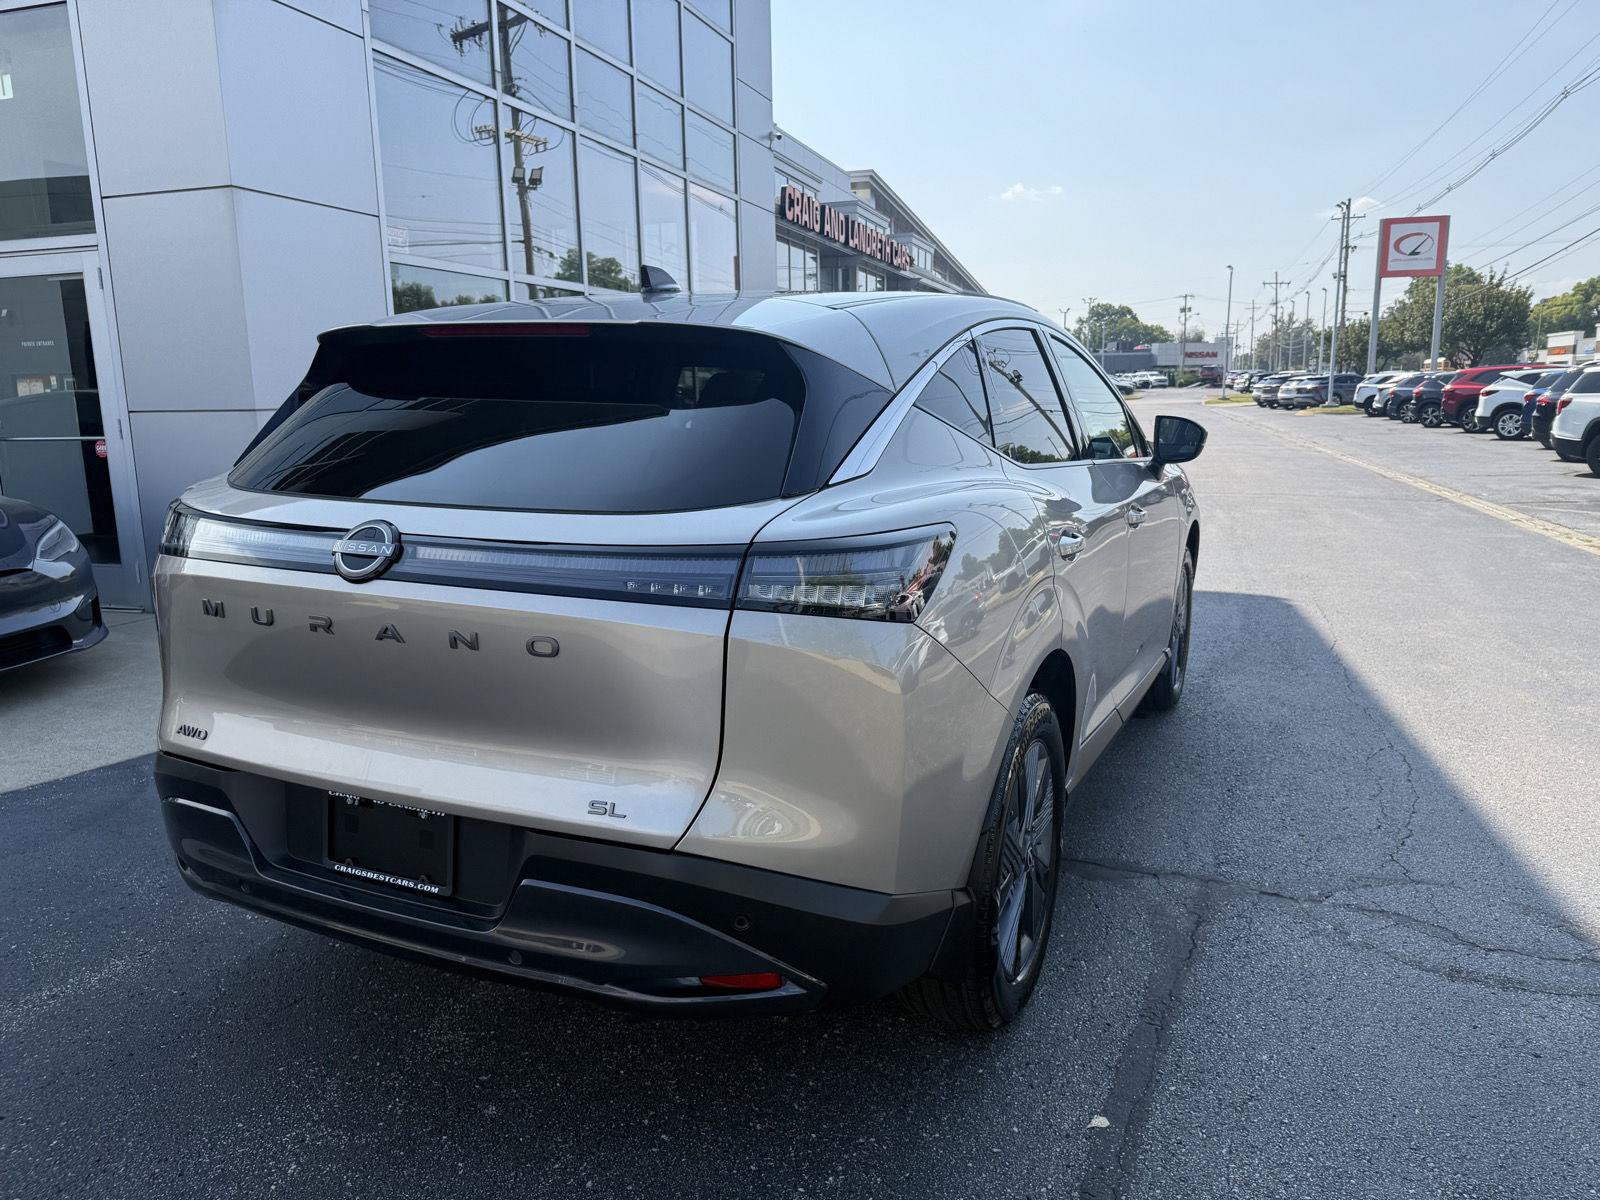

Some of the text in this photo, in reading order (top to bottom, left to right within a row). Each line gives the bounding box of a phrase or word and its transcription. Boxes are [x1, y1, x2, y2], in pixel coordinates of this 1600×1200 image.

[785, 184, 912, 271] CRAIG AND LANDRETH CARS
[334, 540, 393, 554] NISSAN
[202, 598, 560, 658] MURANO
[176, 723, 208, 741] AWD
[587, 799, 627, 819] SL
[334, 864, 439, 894] CRAIGSBESTCARS.COM
